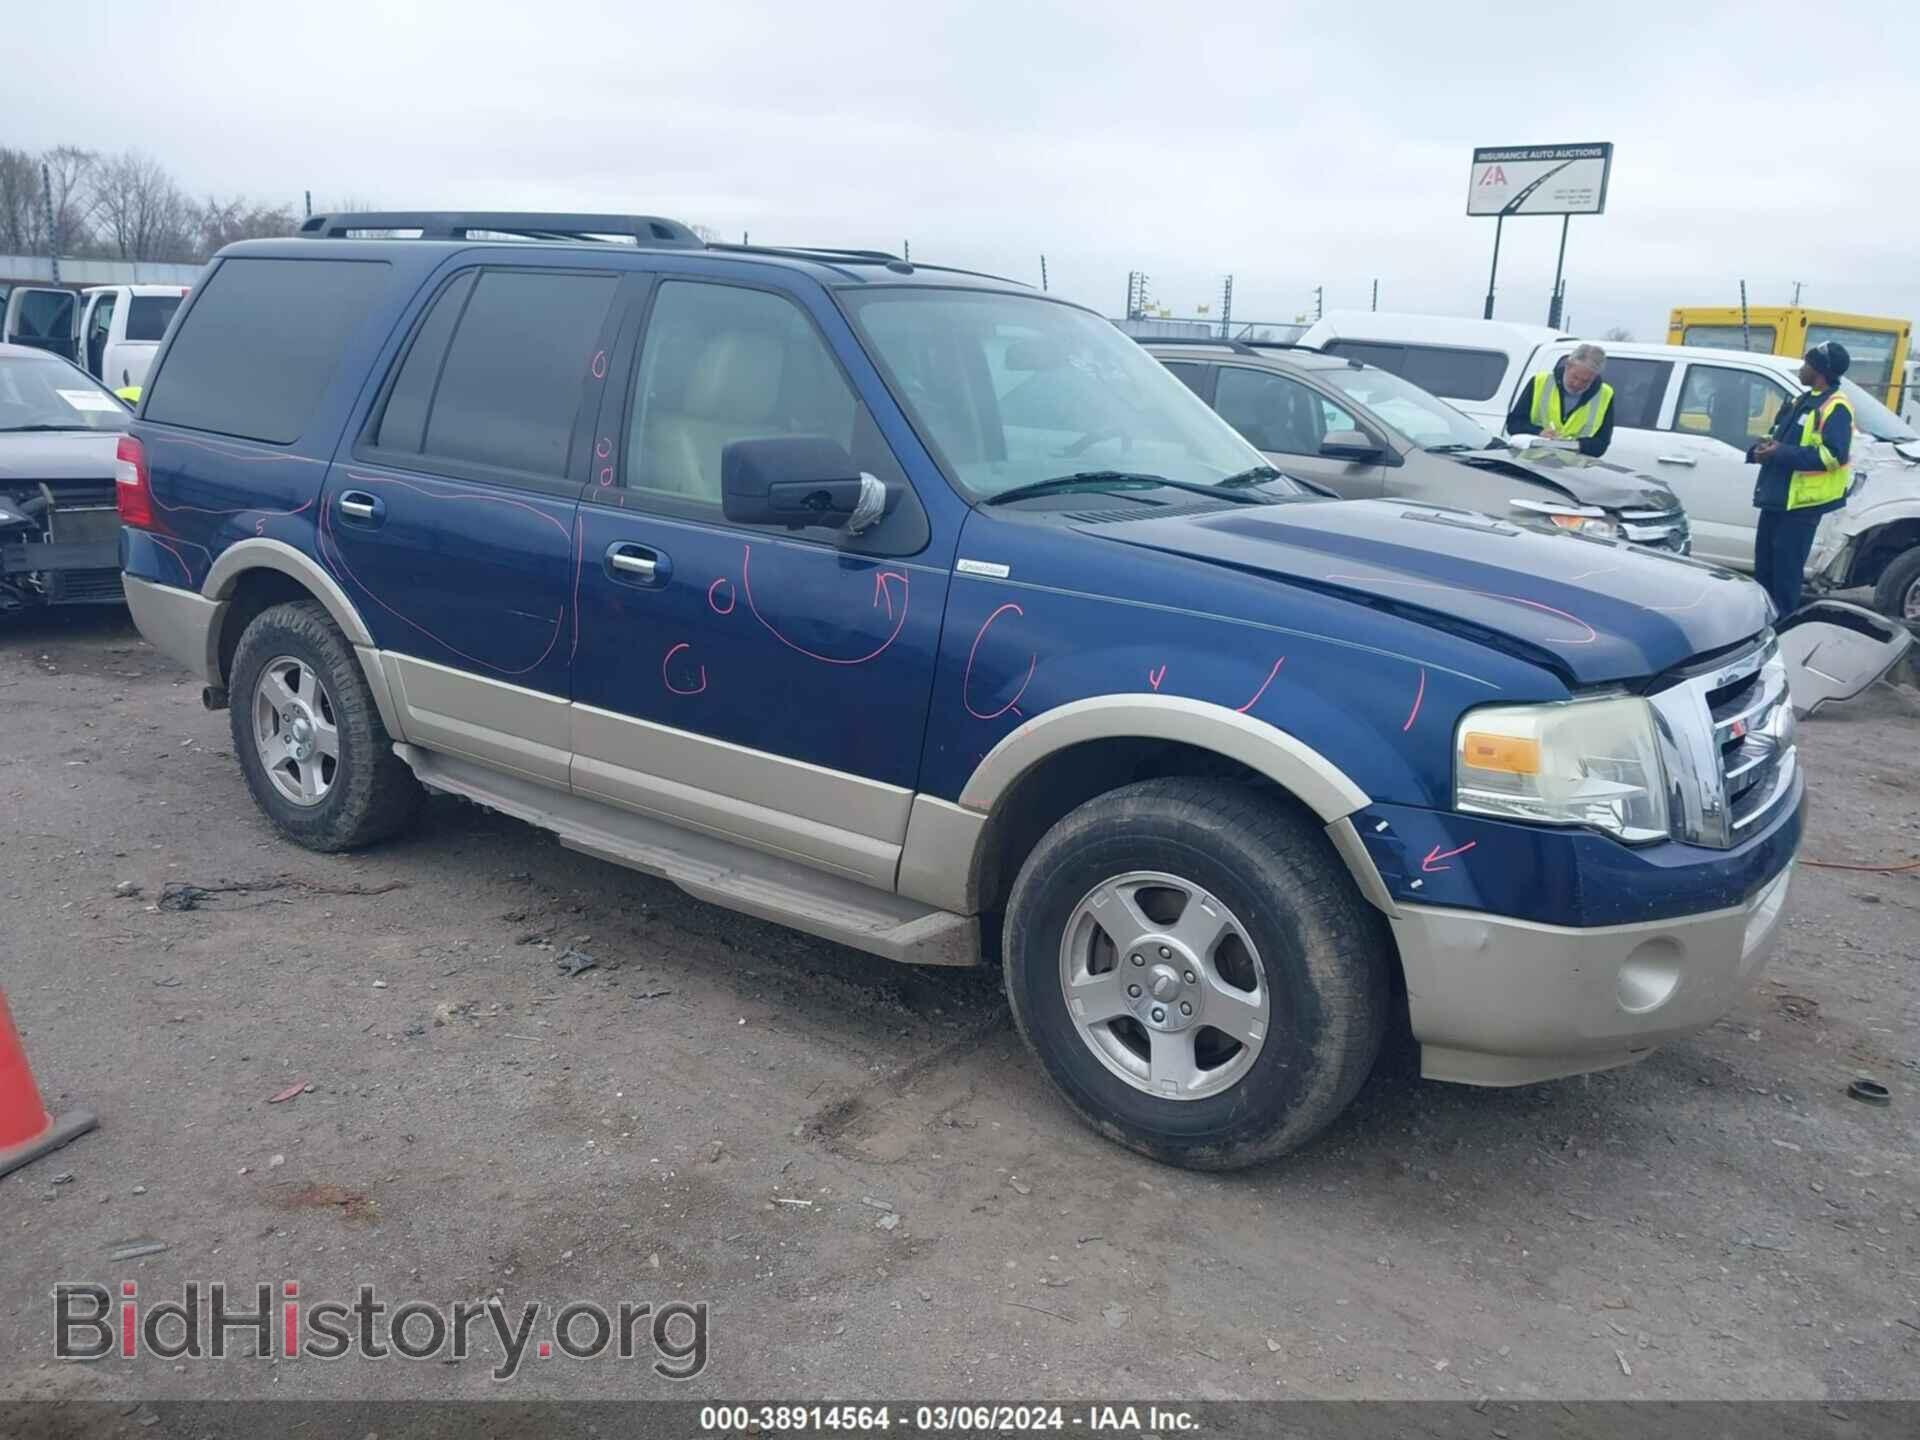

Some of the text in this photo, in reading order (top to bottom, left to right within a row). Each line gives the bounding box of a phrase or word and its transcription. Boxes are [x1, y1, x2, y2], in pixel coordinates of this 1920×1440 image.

[1478, 148, 1602, 161] INSURANCE AUTO AUCTIONS
